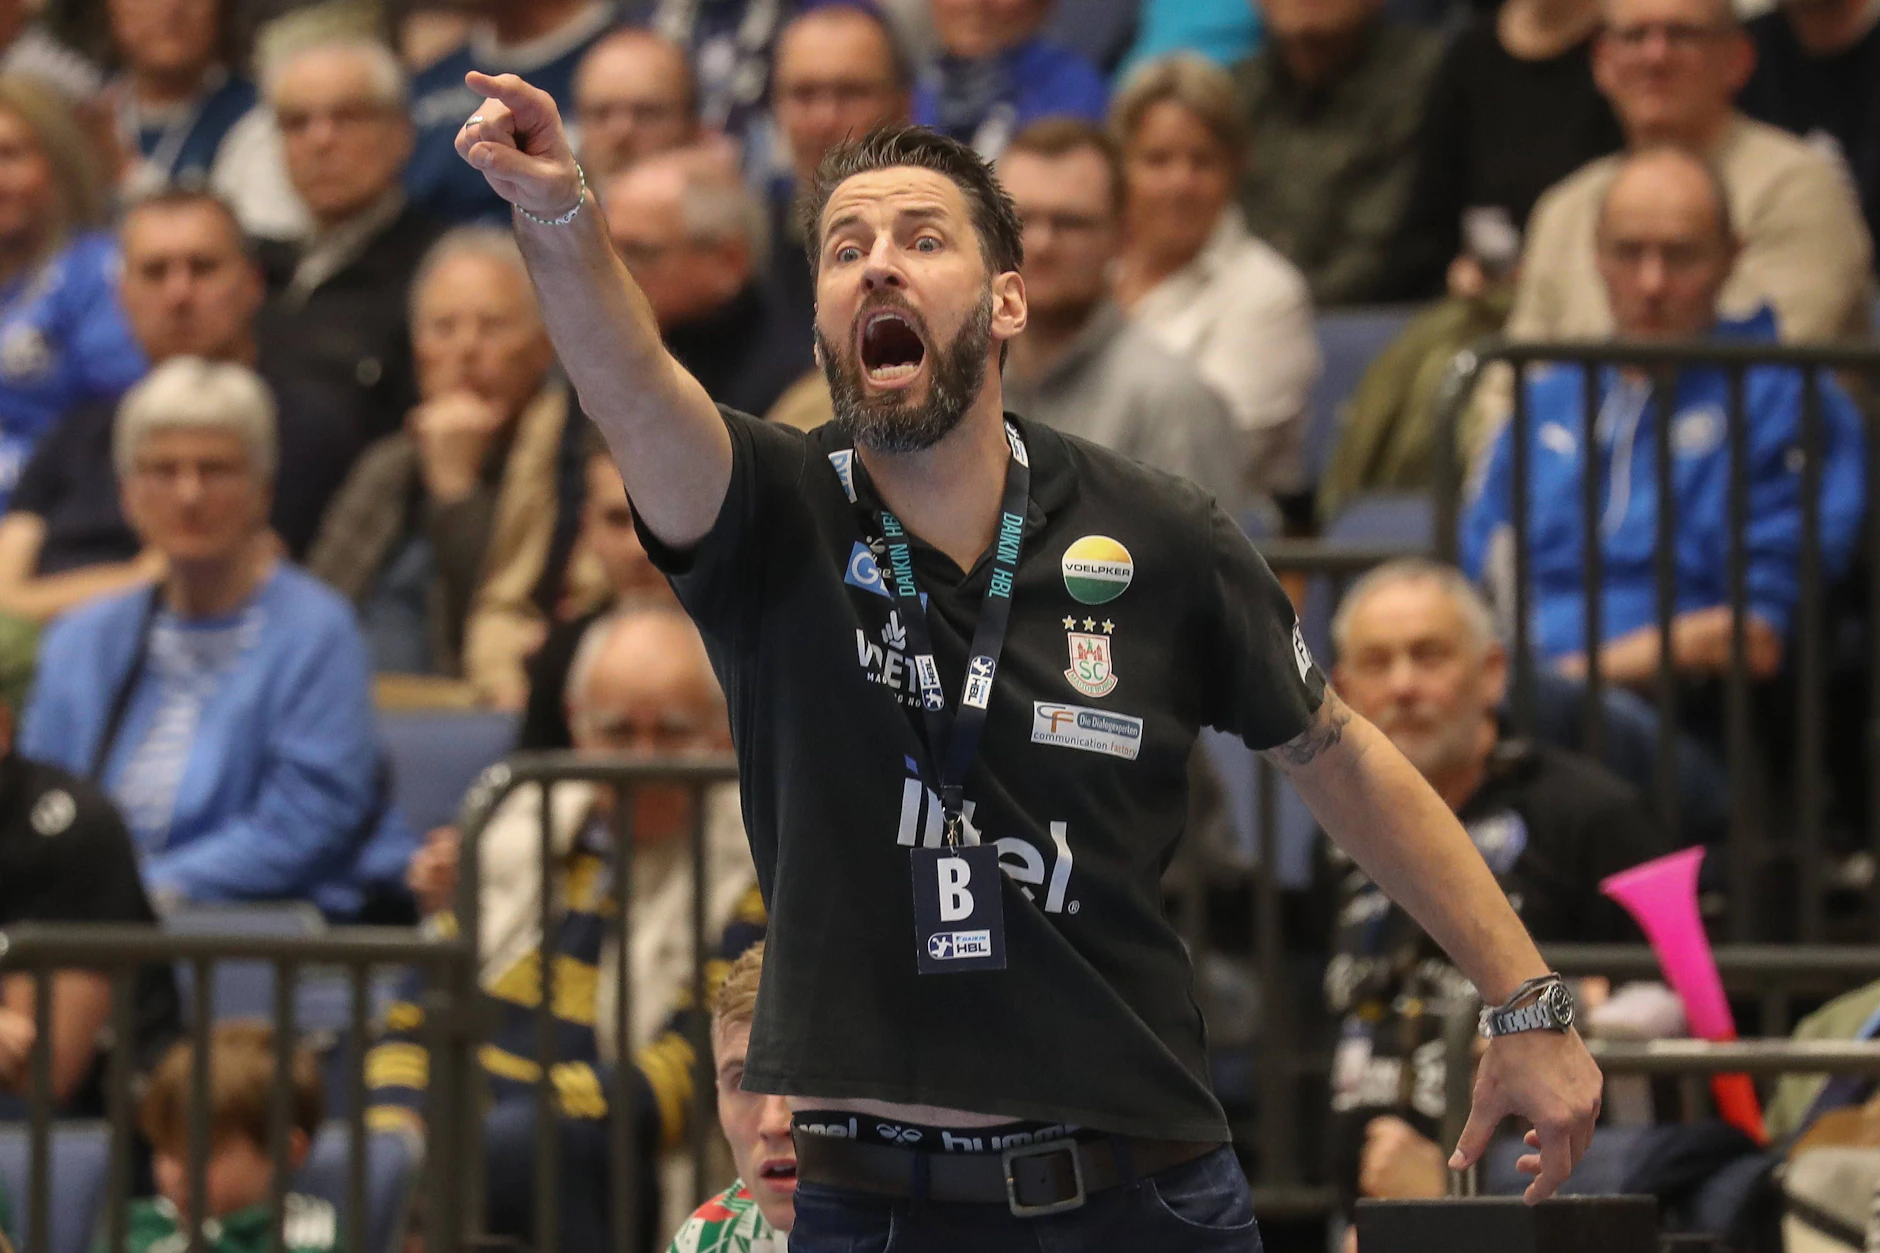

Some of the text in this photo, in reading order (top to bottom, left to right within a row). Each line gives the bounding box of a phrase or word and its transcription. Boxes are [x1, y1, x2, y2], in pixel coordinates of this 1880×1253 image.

[988, 511, 1023, 598] DAIKIN HBL
[889, 543, 917, 597] DAIKIN
[1065, 563, 1131, 577] VOELPKER
[1079, 660, 1104, 681] SC
[1080, 713, 1138, 737] Die Dialogexperten
[1033, 731, 1138, 760] communication factory
[937, 857, 975, 922] B
[956, 942, 987, 953] HBL
